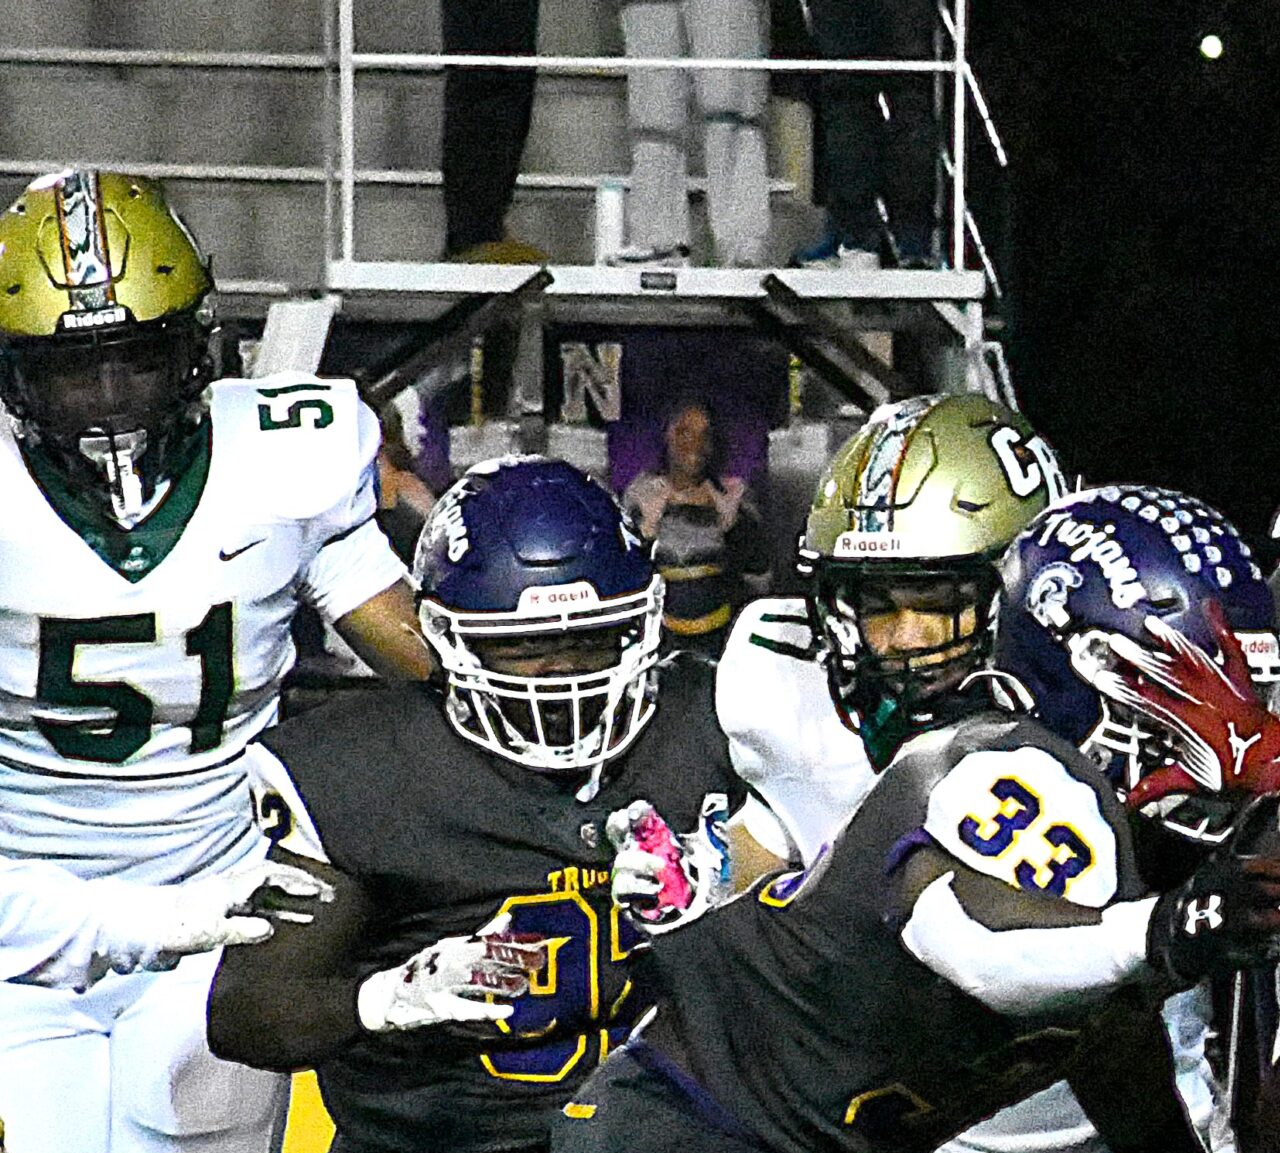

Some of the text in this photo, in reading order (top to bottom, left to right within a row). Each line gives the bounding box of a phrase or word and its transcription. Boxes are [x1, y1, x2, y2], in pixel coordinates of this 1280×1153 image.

[256, 383, 334, 431] 51
[1038, 511, 1147, 609] Trojans
[34, 600, 234, 765] 51
[957, 774, 1096, 898] 33
